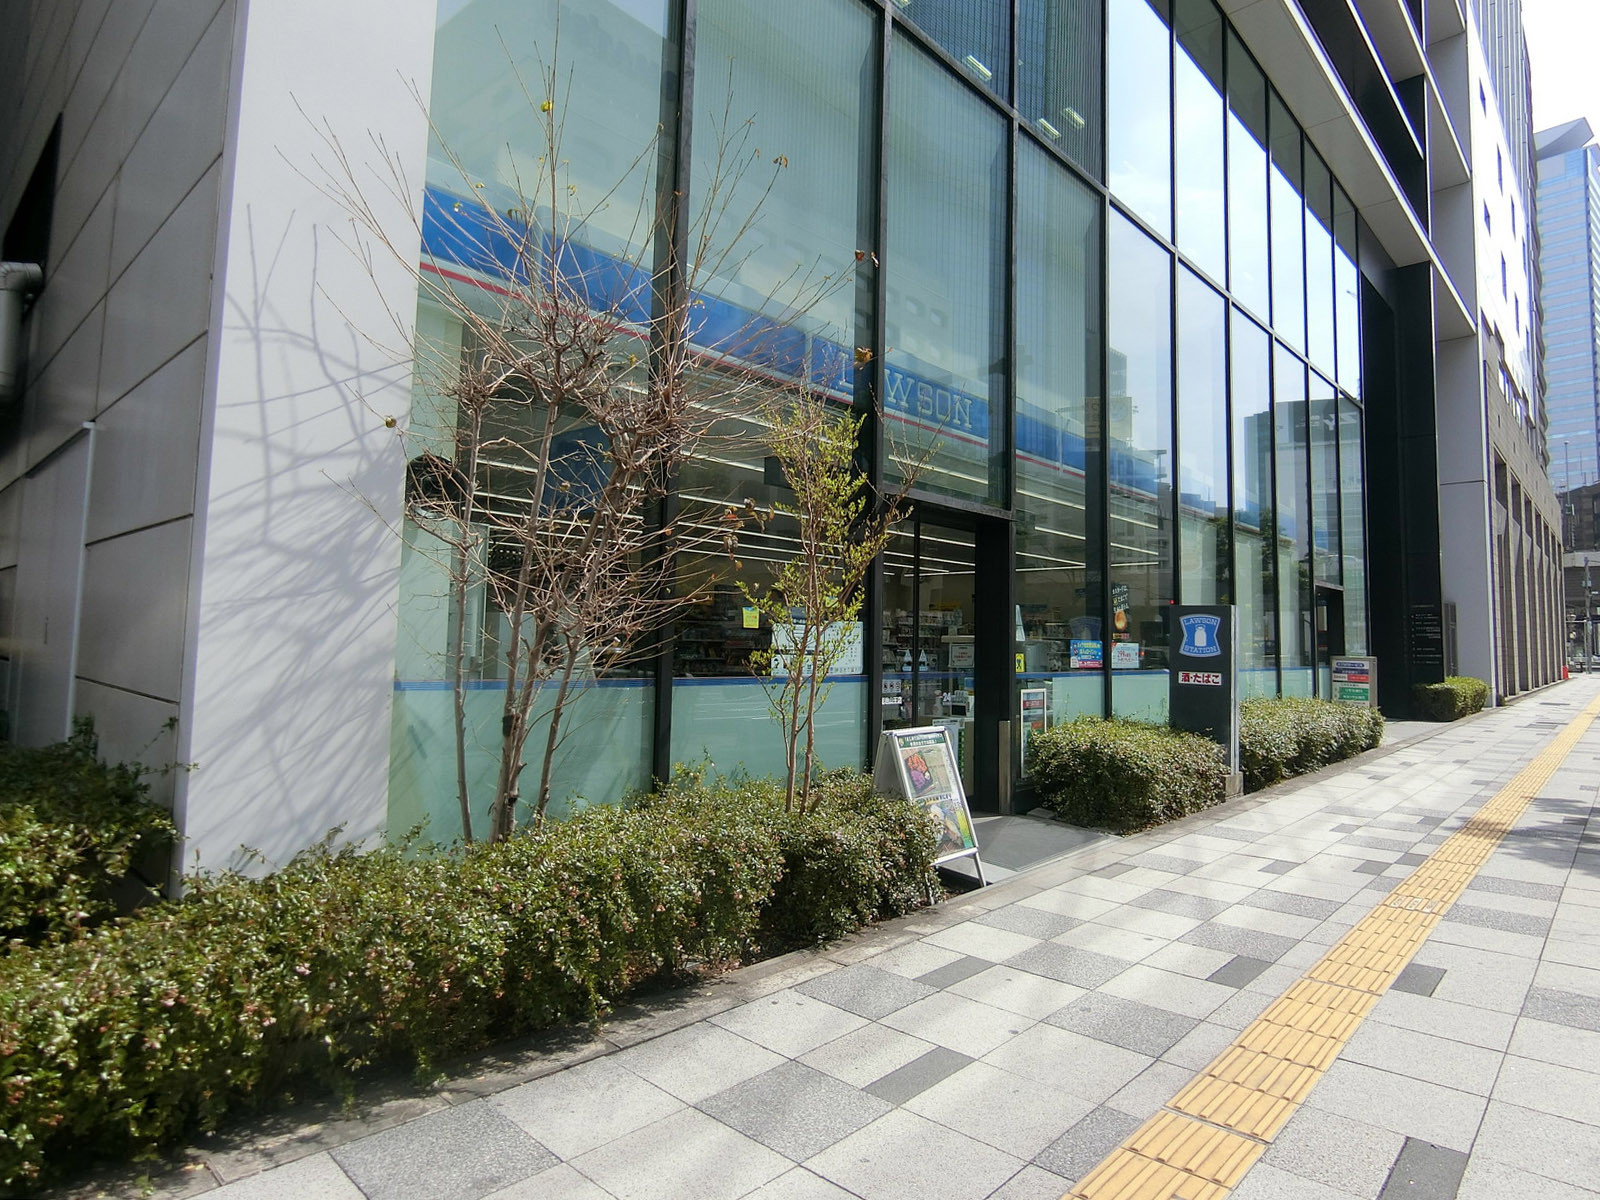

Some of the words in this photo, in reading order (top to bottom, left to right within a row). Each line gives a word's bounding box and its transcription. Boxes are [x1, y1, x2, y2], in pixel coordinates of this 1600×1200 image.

[839, 352, 973, 428] LWSON
[1183, 617, 1218, 626] LAWSON
[1183, 645, 1218, 654] STATION
